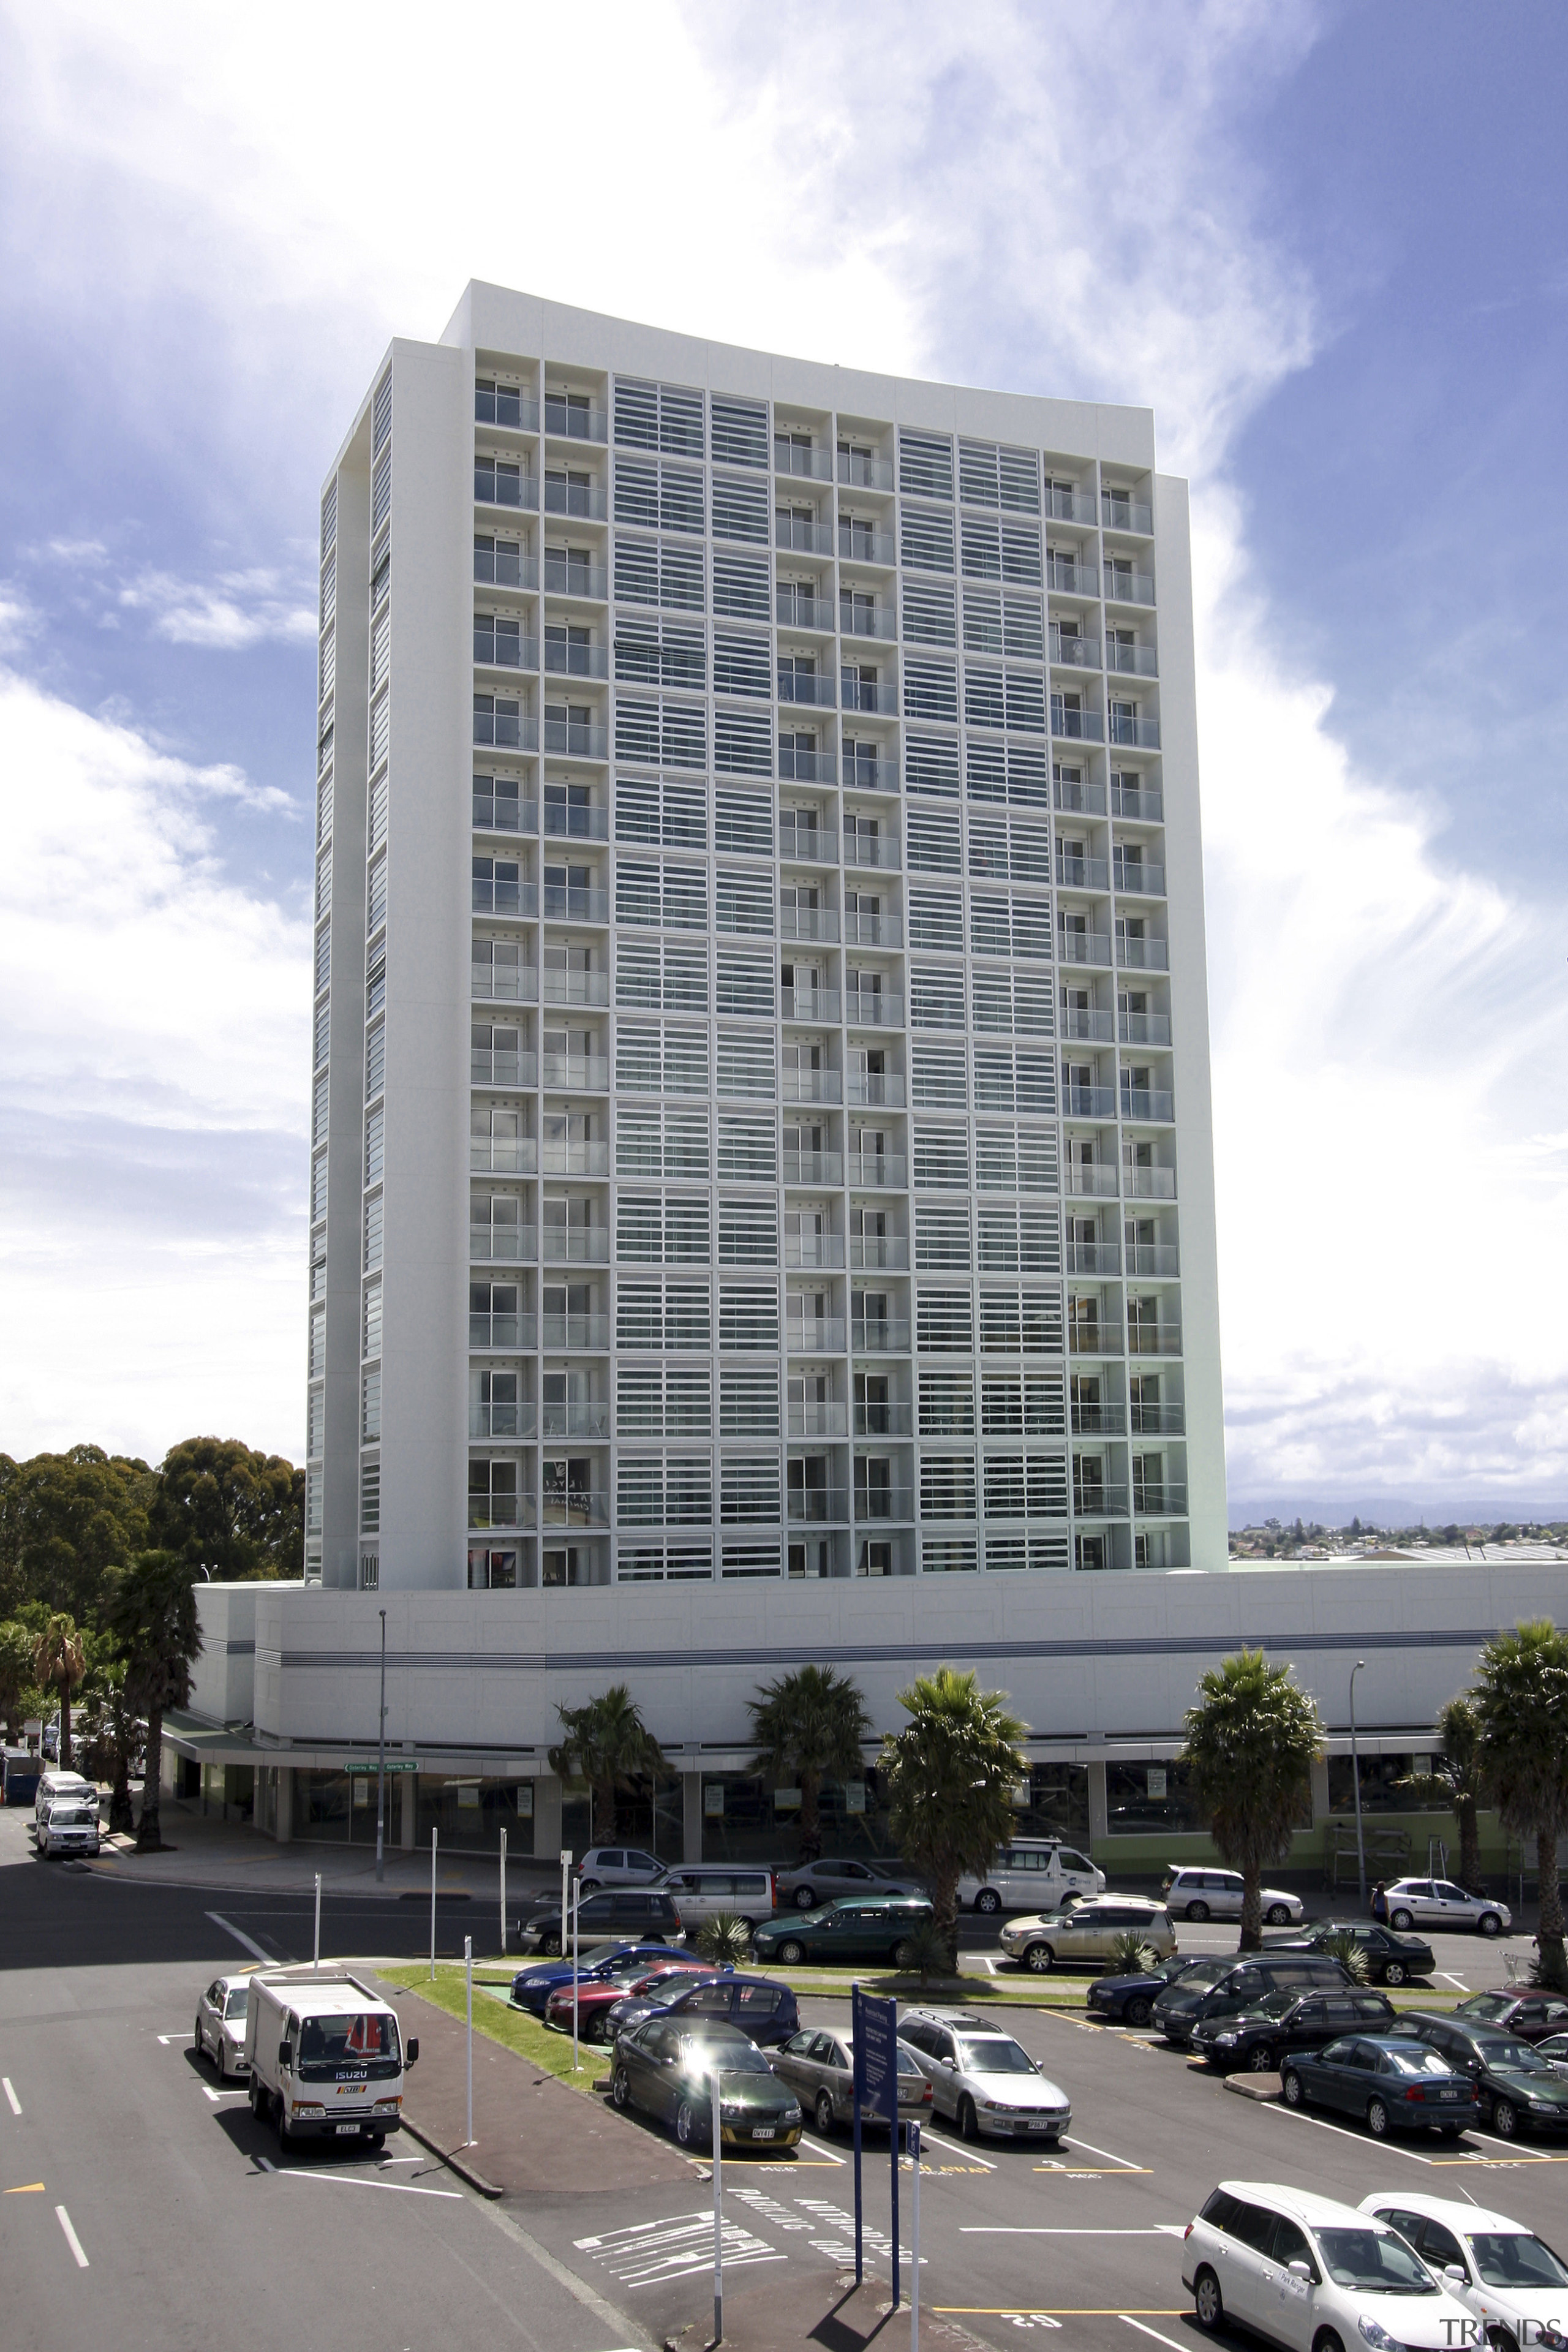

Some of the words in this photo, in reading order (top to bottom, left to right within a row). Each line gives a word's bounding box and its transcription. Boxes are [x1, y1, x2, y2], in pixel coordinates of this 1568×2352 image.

[336, 2071, 367, 2079] ISUZU
[911, 2125, 916, 2138] P
[726, 2188, 816, 2230] PARKING
[808, 2240, 876, 2264] ONLY
[793, 2199, 929, 2264] AUTHORISED
[572, 2210, 788, 2288] ENTRY
[1281, 2273, 1291, 2285] Park
[1290, 2279, 1305, 2293] Ranger
